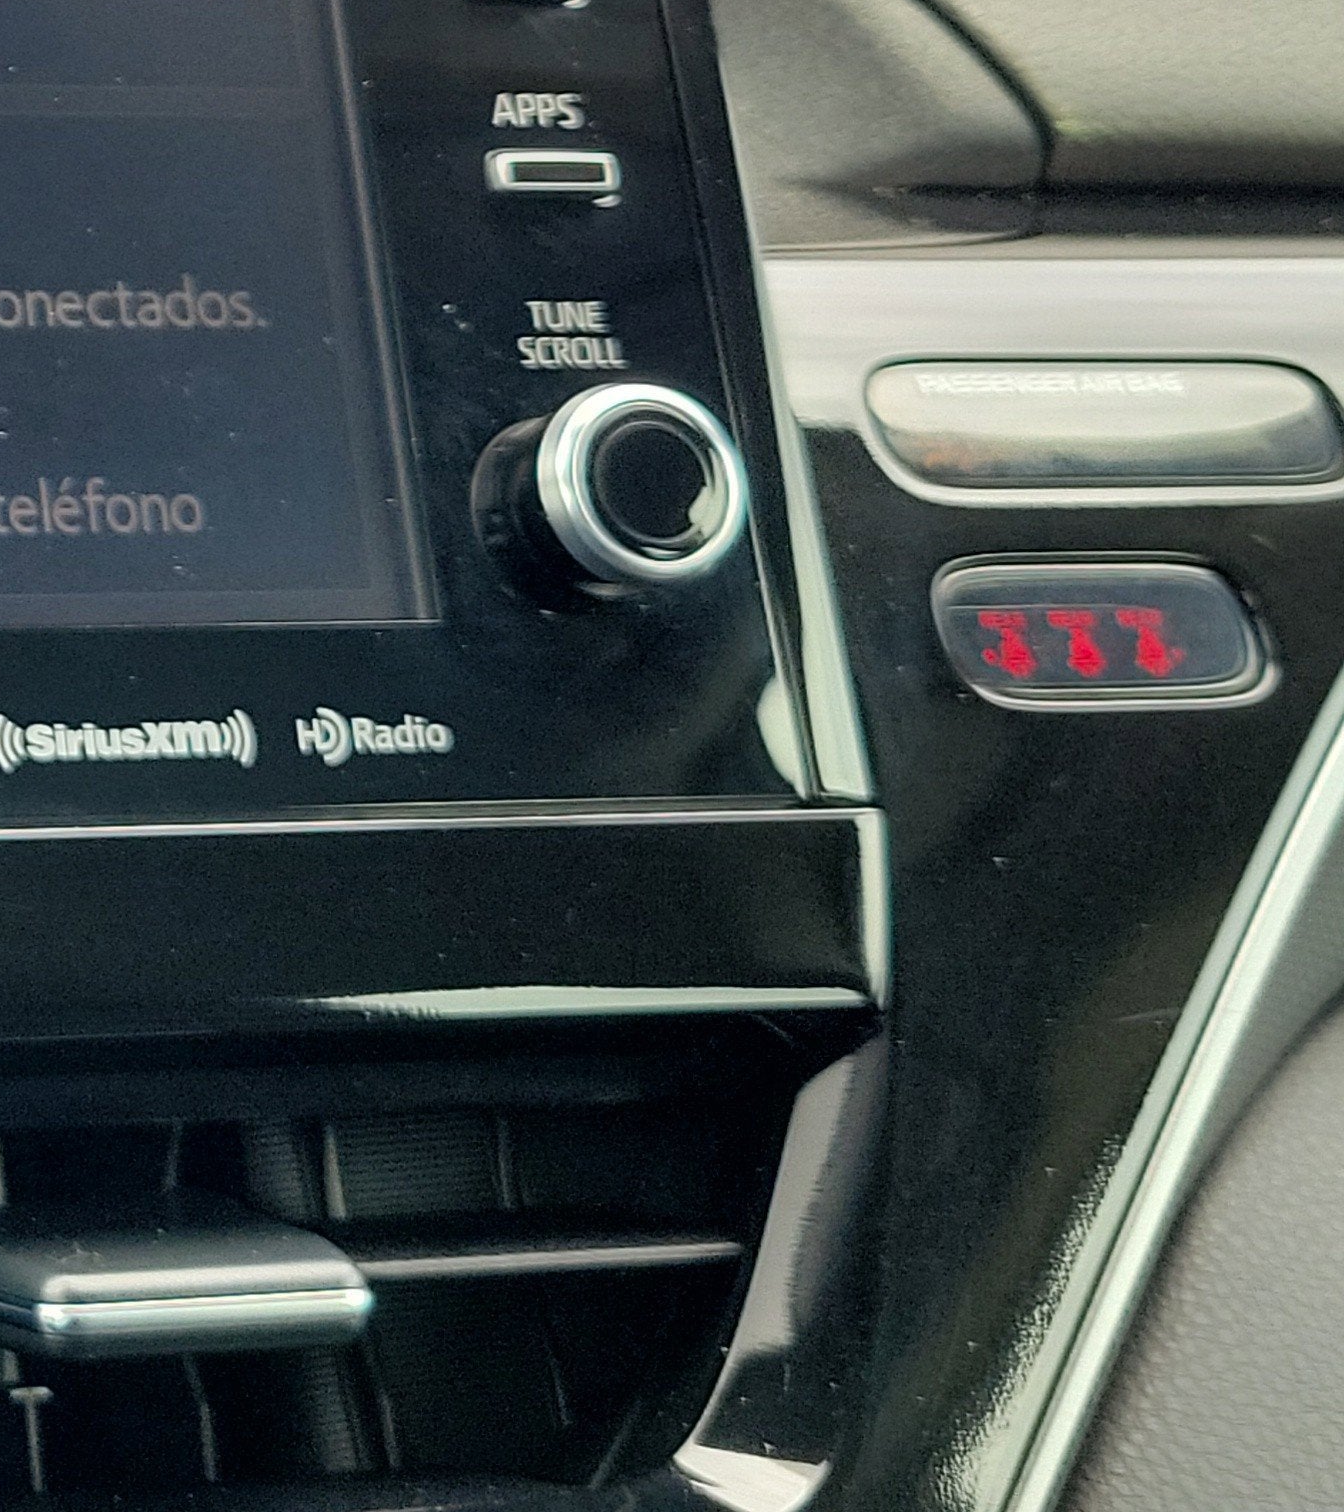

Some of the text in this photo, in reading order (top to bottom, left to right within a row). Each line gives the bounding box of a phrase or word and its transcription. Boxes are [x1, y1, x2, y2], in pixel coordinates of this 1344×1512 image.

[491, 91, 586, 130] APPS
[523, 299, 611, 334] TUNE
[517, 335, 629, 370] SCROLL
[353, 713, 455, 755] Radio
